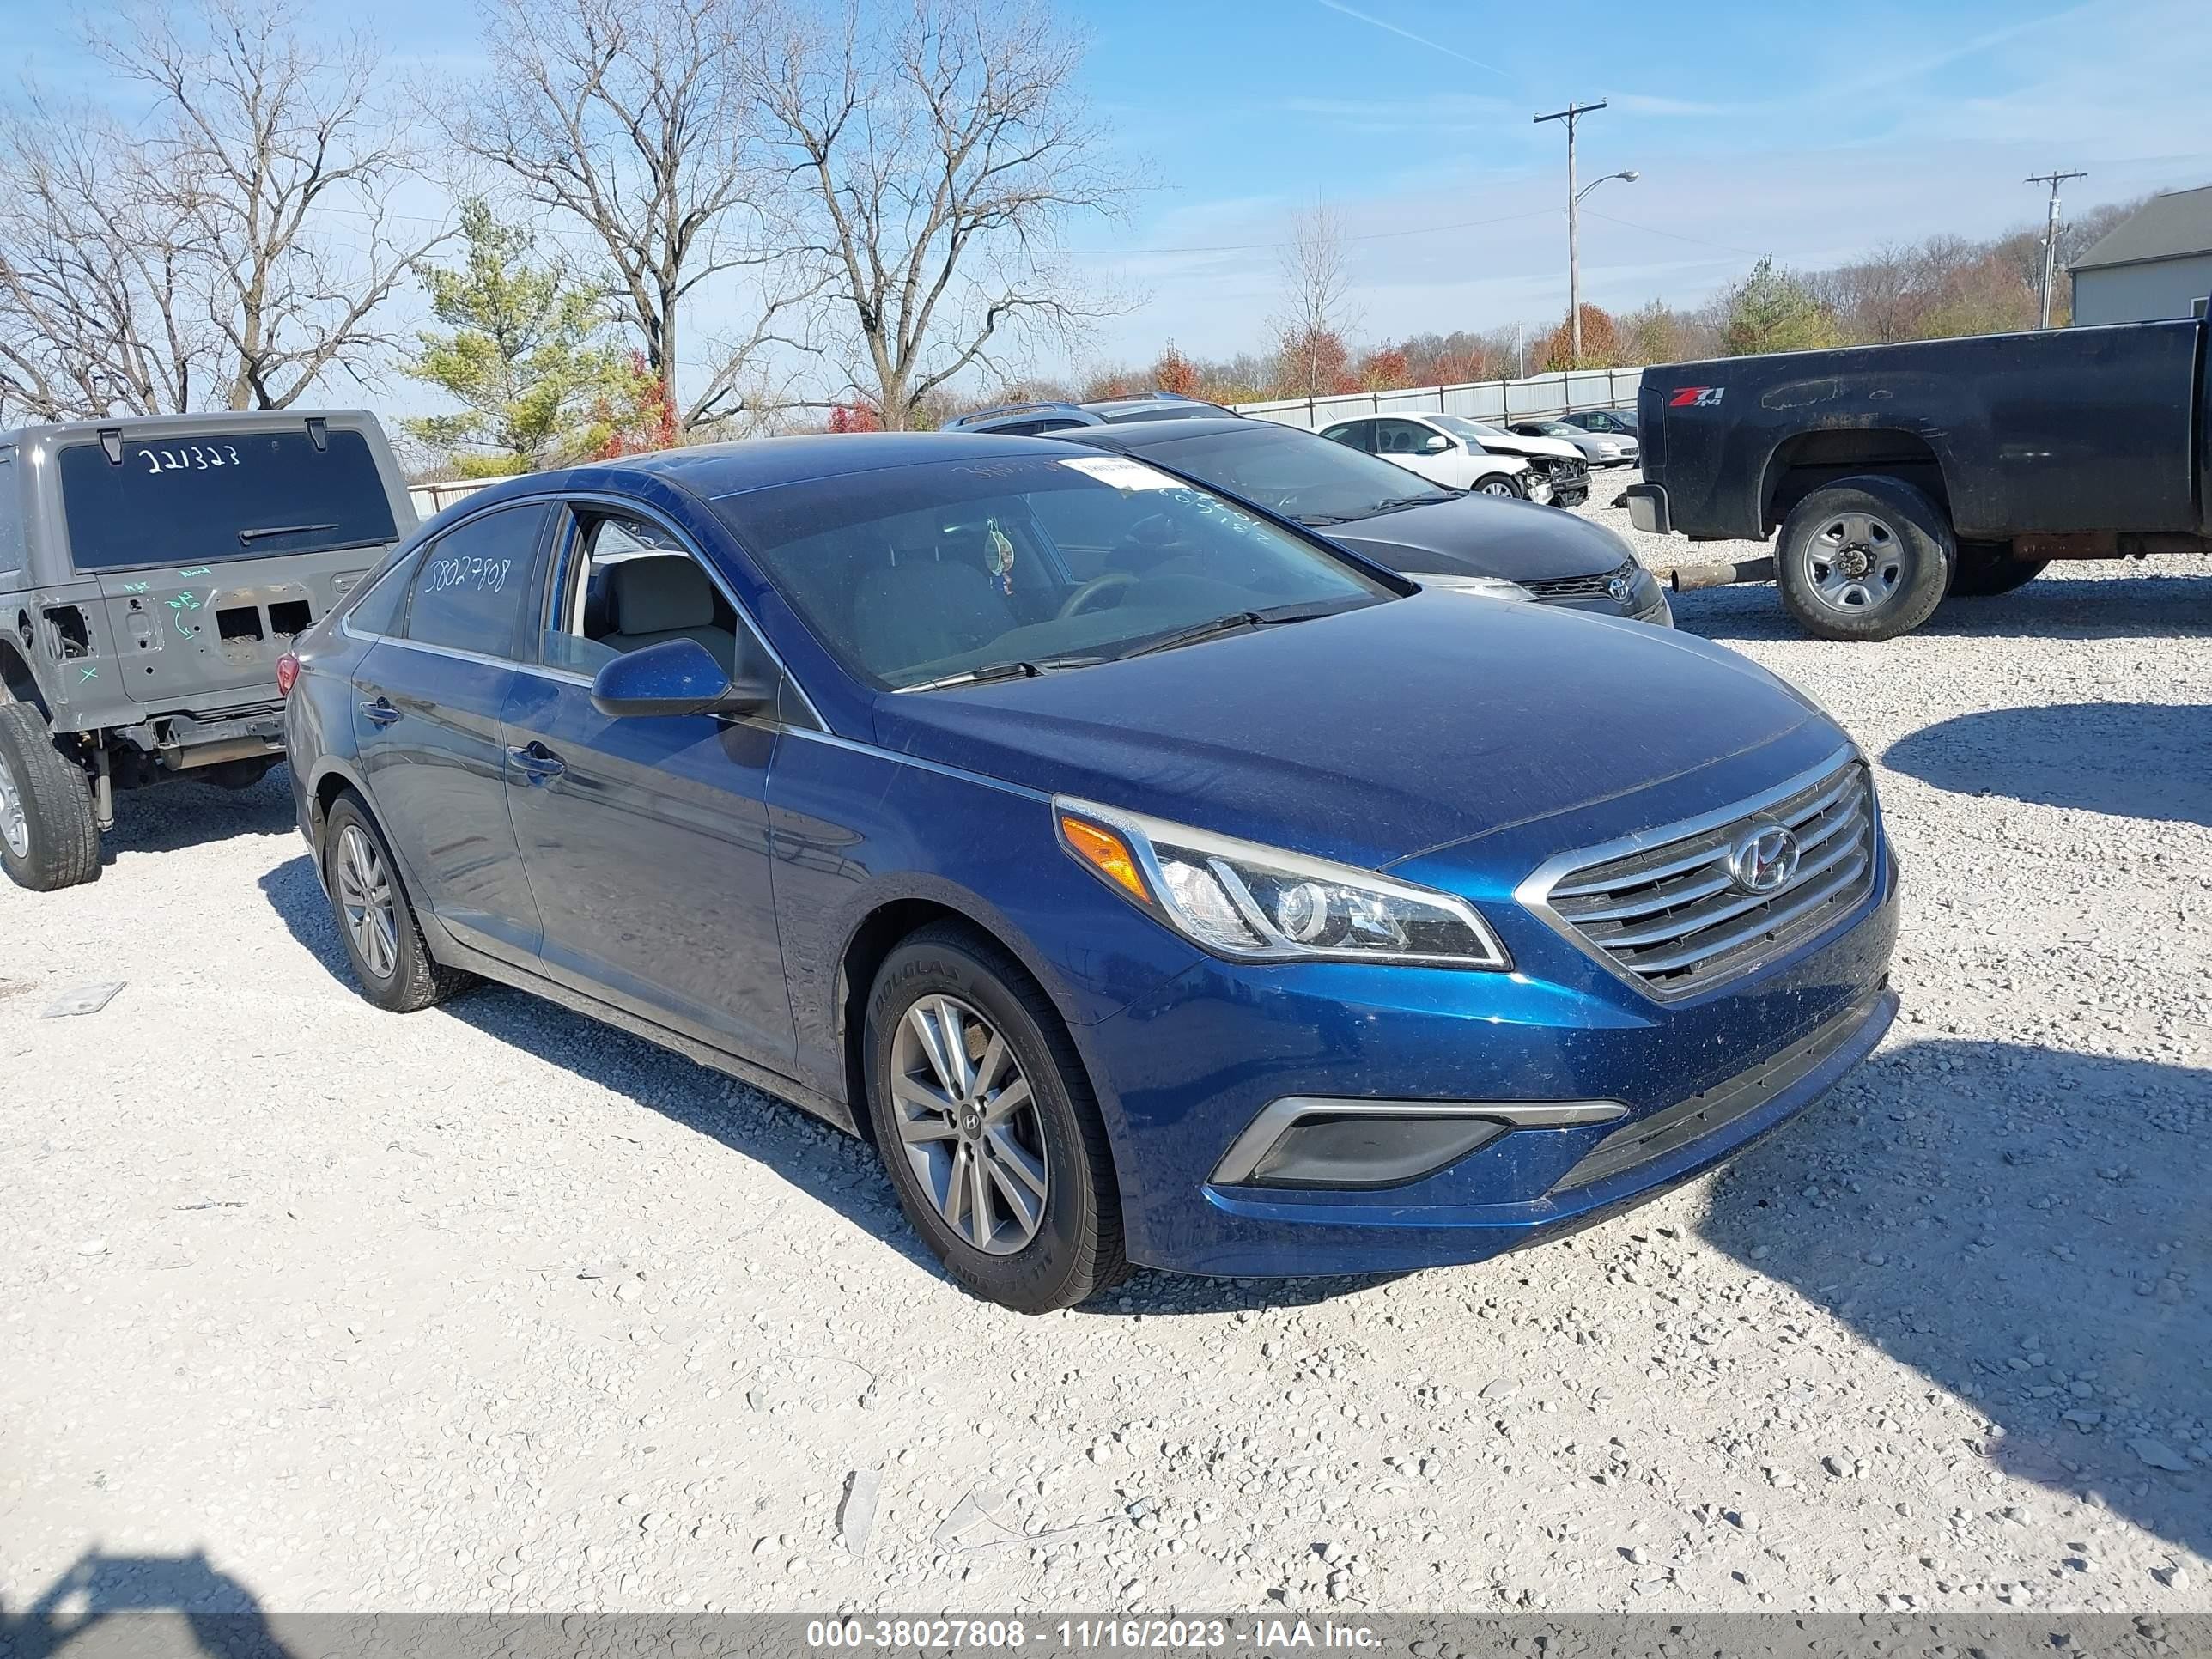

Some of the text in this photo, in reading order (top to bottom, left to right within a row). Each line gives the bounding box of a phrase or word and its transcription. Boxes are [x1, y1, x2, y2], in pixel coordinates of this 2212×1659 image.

[1669, 386, 1725, 407] Z71
[138, 445, 240, 474] 221323
[424, 556, 511, 593] 38027808
[875, 960, 961, 1014] DOUGLAS
